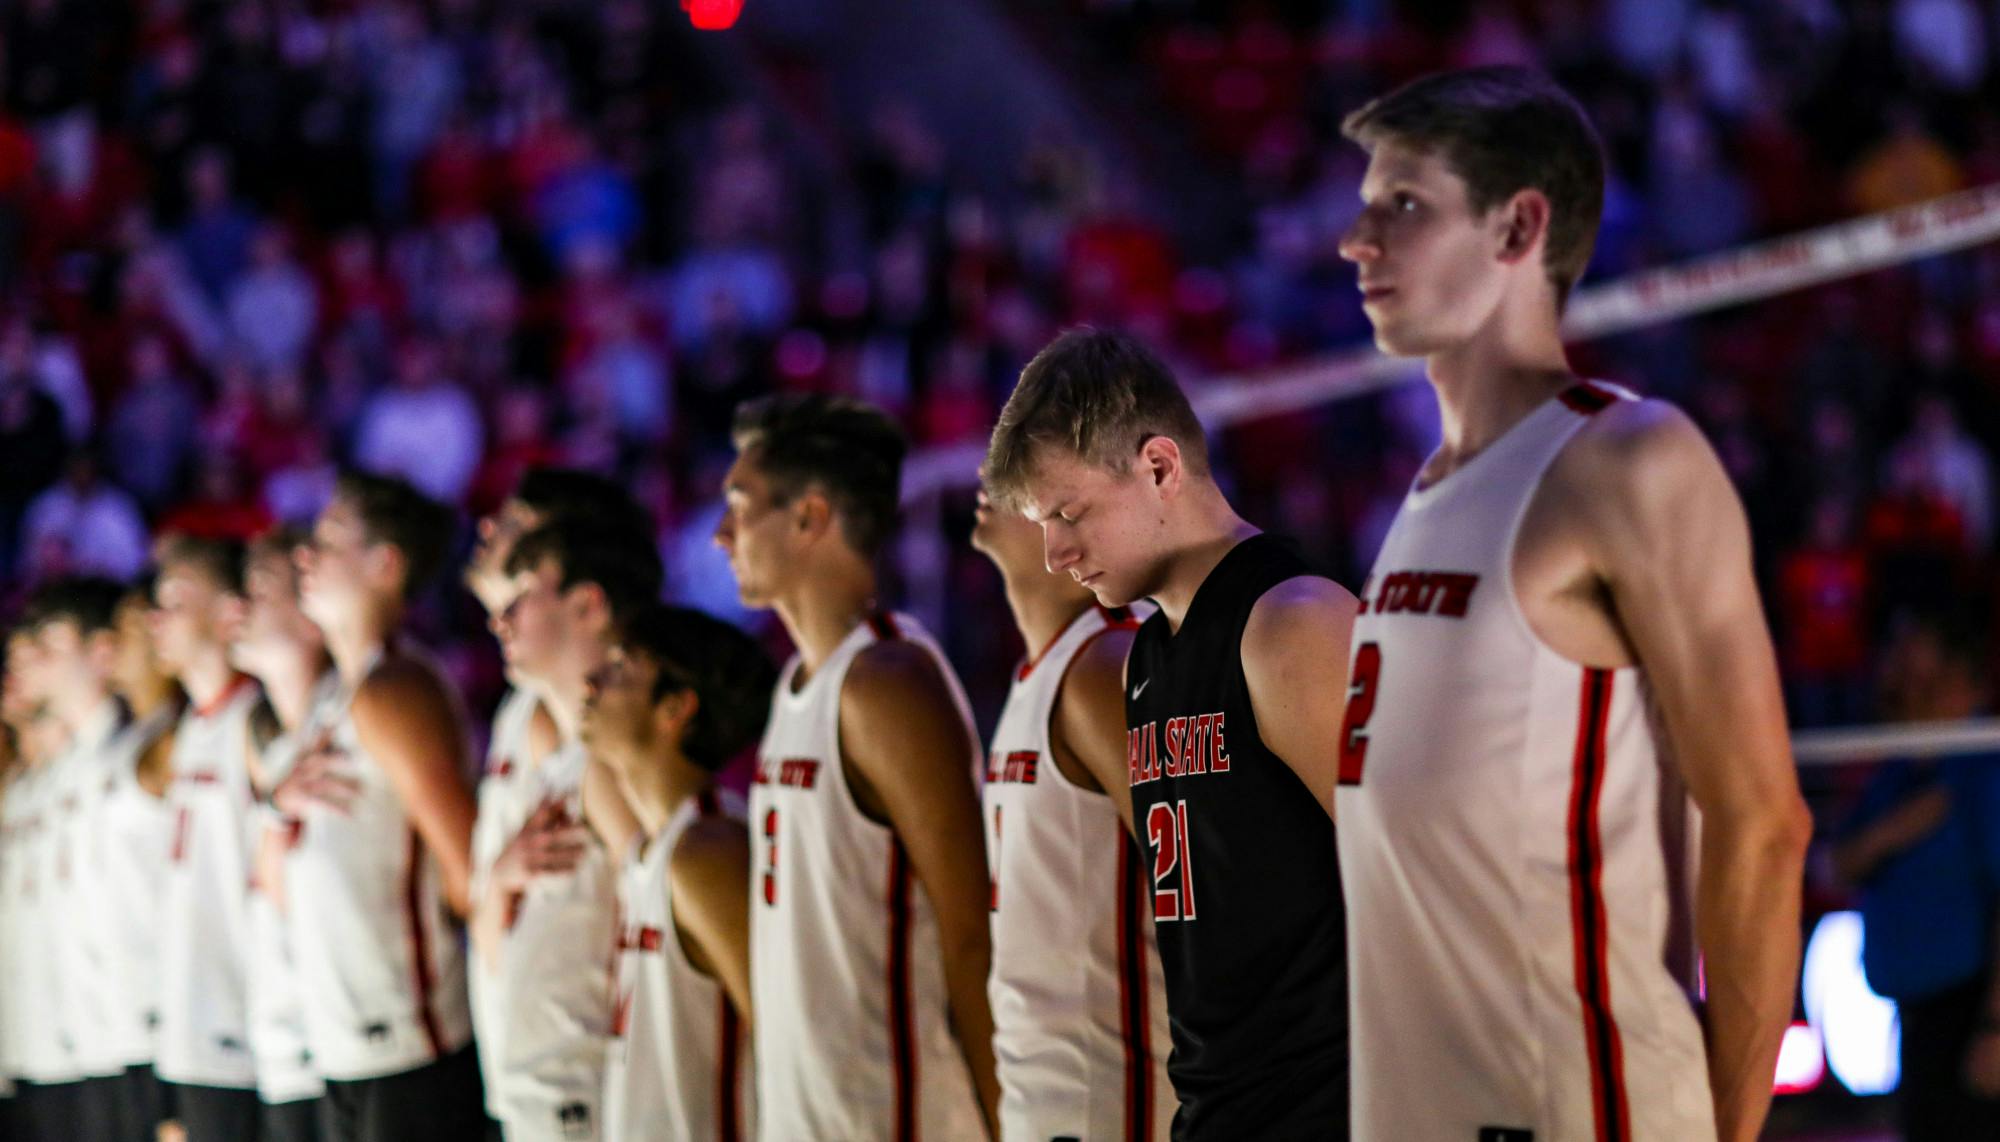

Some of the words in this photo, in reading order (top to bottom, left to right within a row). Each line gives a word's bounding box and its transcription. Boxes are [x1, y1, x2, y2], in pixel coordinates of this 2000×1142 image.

[1127, 721, 1162, 787] ALL
[1164, 711, 1230, 778] STATE
[1337, 641, 1382, 785] 2
[1147, 799, 1196, 922] 21
